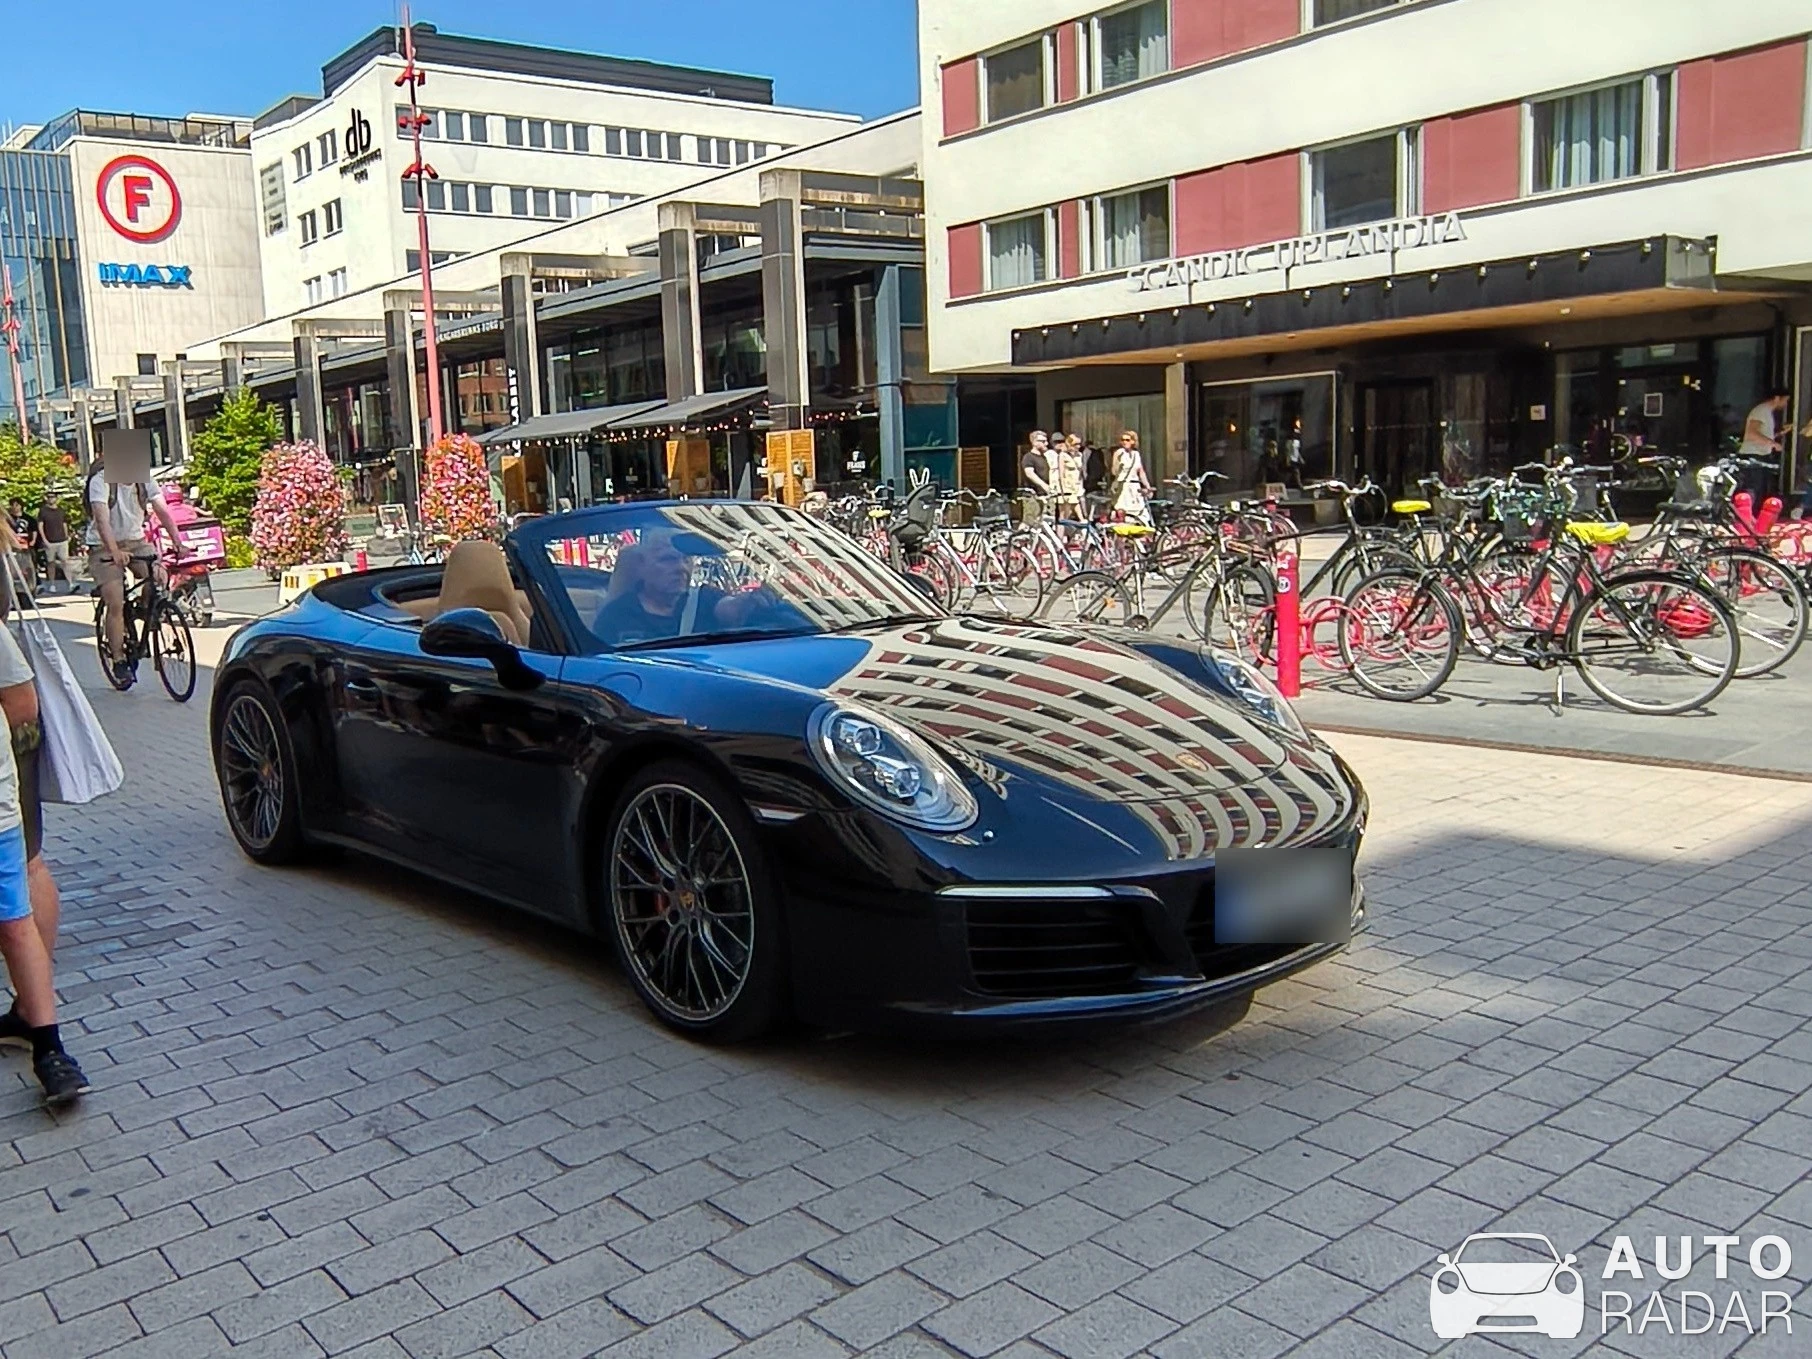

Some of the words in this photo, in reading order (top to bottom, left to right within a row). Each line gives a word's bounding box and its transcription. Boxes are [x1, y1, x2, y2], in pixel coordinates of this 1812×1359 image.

[345, 107, 371, 160] db
[123, 175, 153, 223] F
[98, 262, 192, 287] IMAX
[1127, 247, 1259, 293] SCANDIC
[1274, 212, 1467, 270] UPLANDIA
